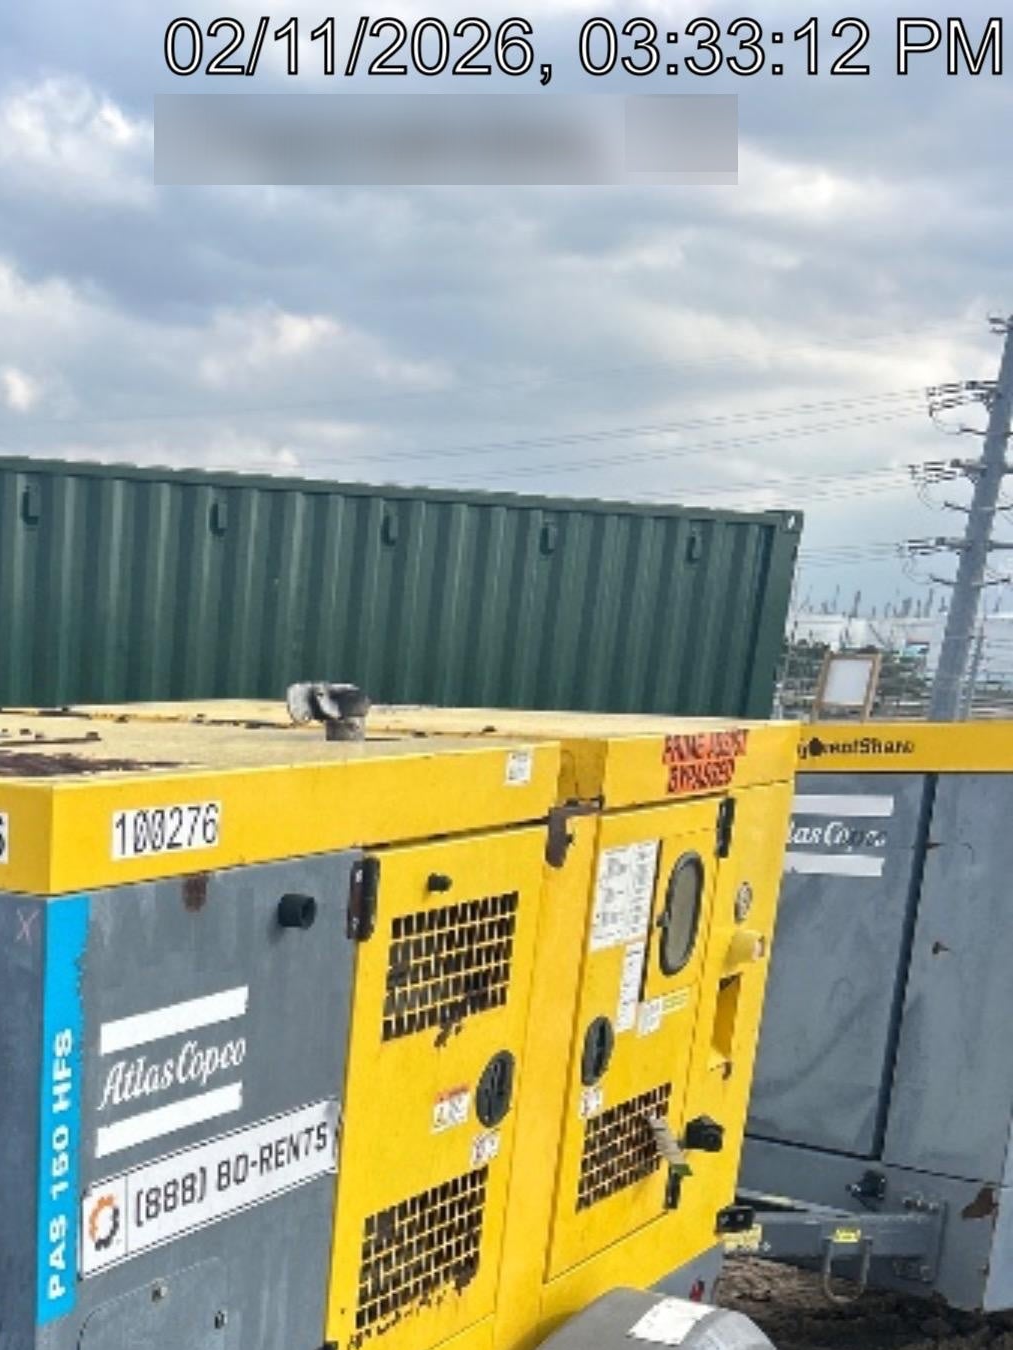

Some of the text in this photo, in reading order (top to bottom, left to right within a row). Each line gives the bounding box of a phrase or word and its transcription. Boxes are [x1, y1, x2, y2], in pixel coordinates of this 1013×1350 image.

[115, 803, 219, 856] 100276
[135, 1120, 328, 1228] (888) 80-RENTS
[48, 1213, 68, 1300] PAS
